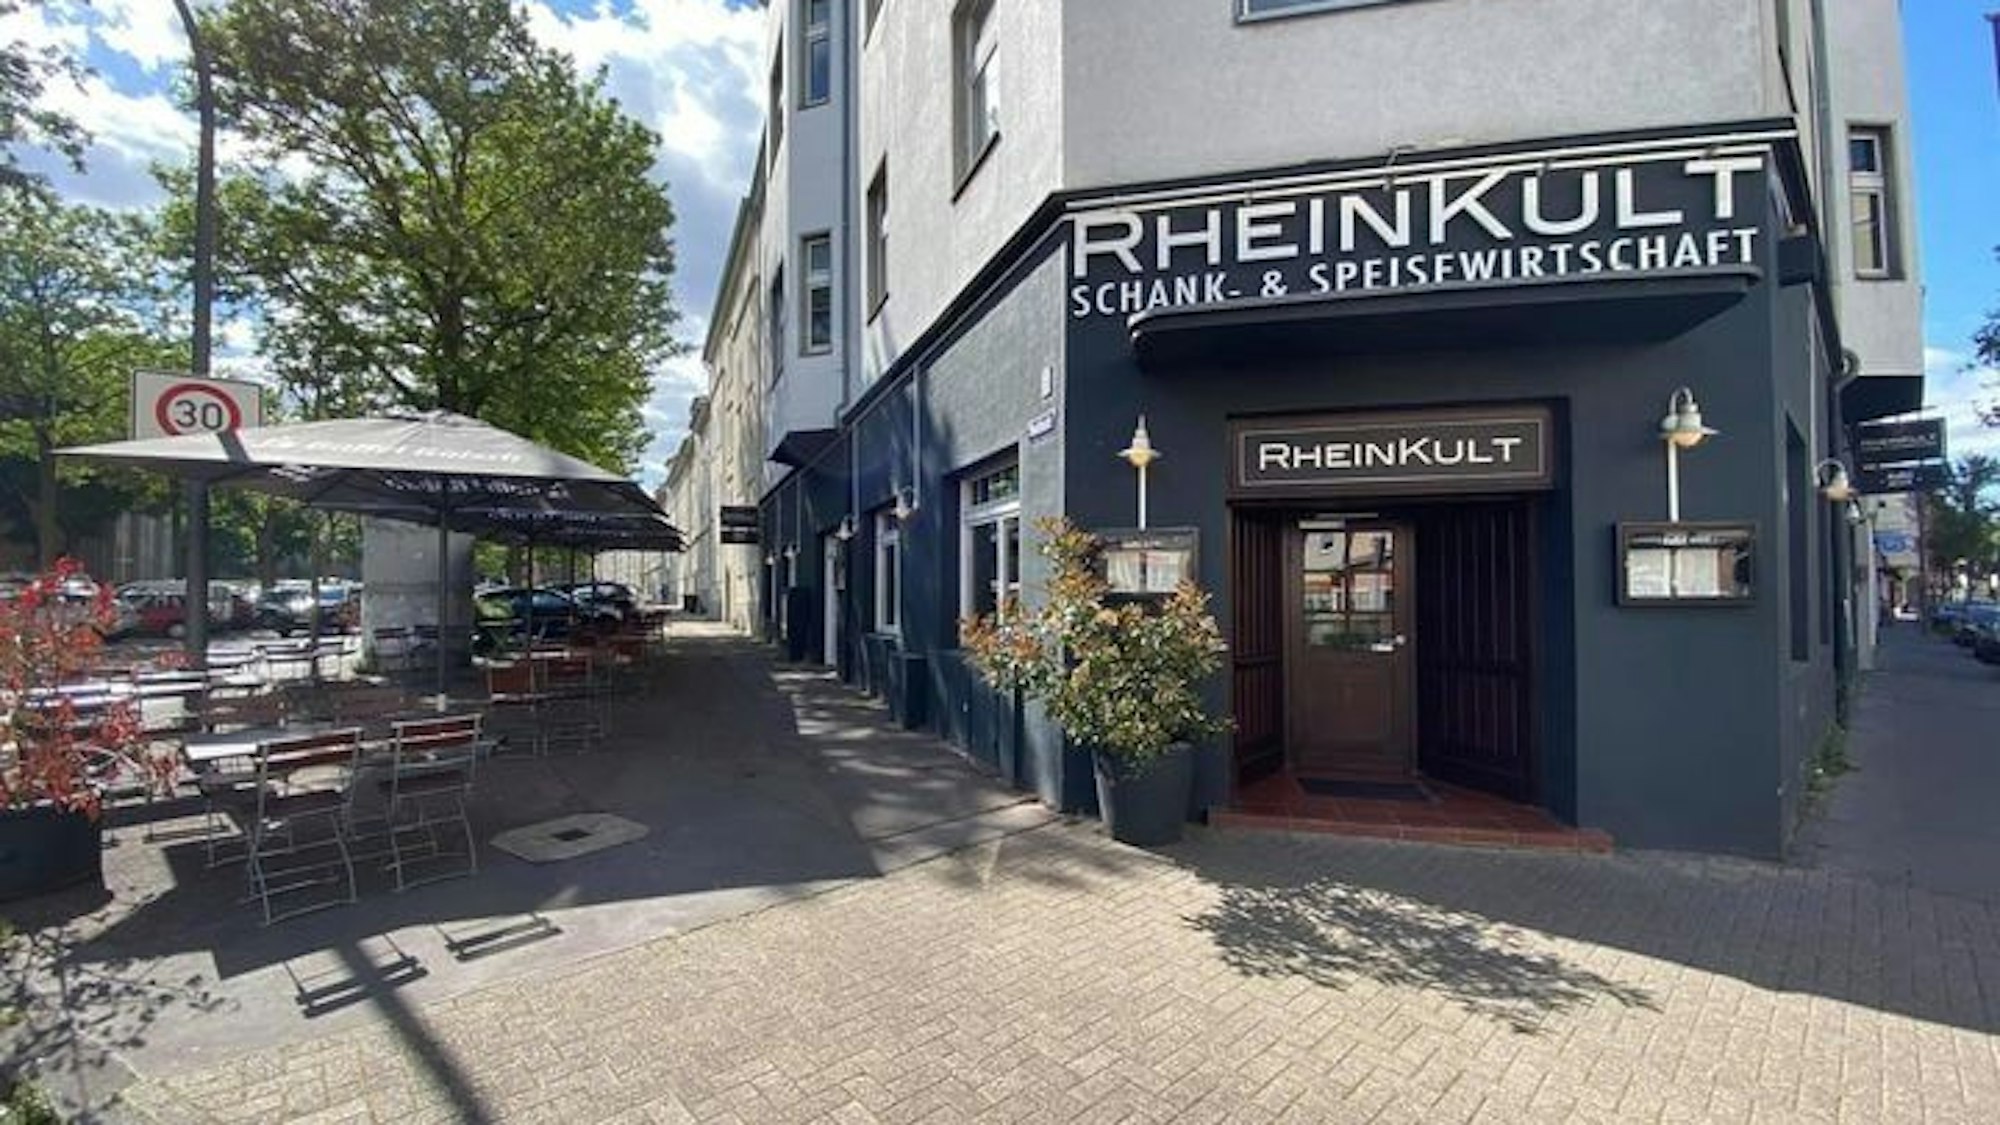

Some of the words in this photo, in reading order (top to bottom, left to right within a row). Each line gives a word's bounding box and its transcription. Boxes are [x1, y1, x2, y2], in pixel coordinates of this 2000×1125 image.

[1073, 157, 1763, 277] RHEINKULT
[1071, 272, 1241, 318] SCHANK-
[1260, 270, 1288, 298] &
[1310, 228, 1758, 294] SPEISEWIRTSCHAFT
[175, 400, 222, 430] 30
[1259, 436, 1522, 471] RHEINKULT
